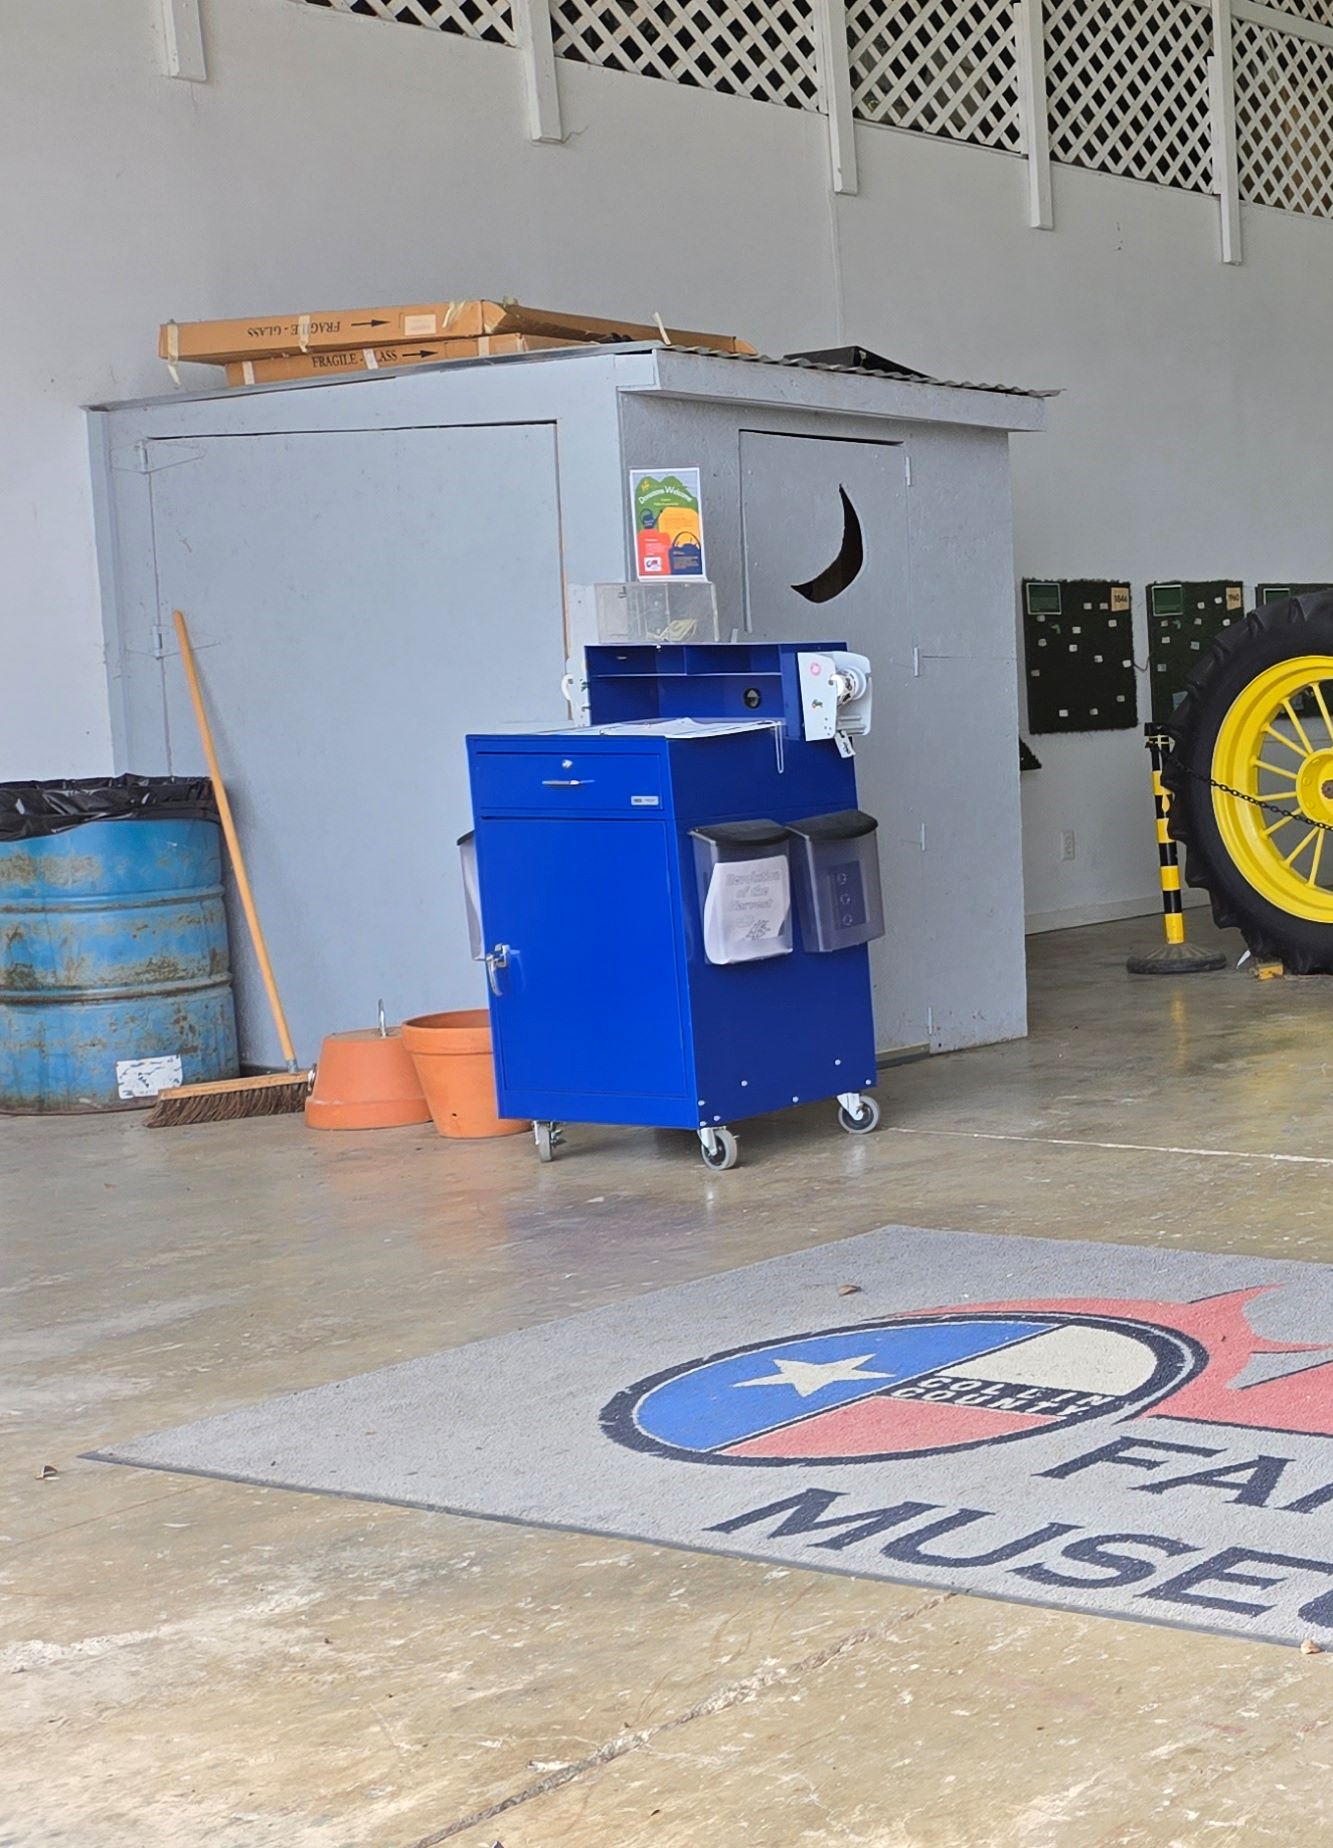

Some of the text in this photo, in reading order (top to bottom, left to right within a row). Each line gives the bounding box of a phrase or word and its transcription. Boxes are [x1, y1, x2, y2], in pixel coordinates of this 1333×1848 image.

[247, 325, 282, 337] GLASS
[311, 352, 358, 369] FRAGILE
[890, 1388, 1090, 1416] COUNTY
[917, 1377, 1116, 1406] COLLIN
